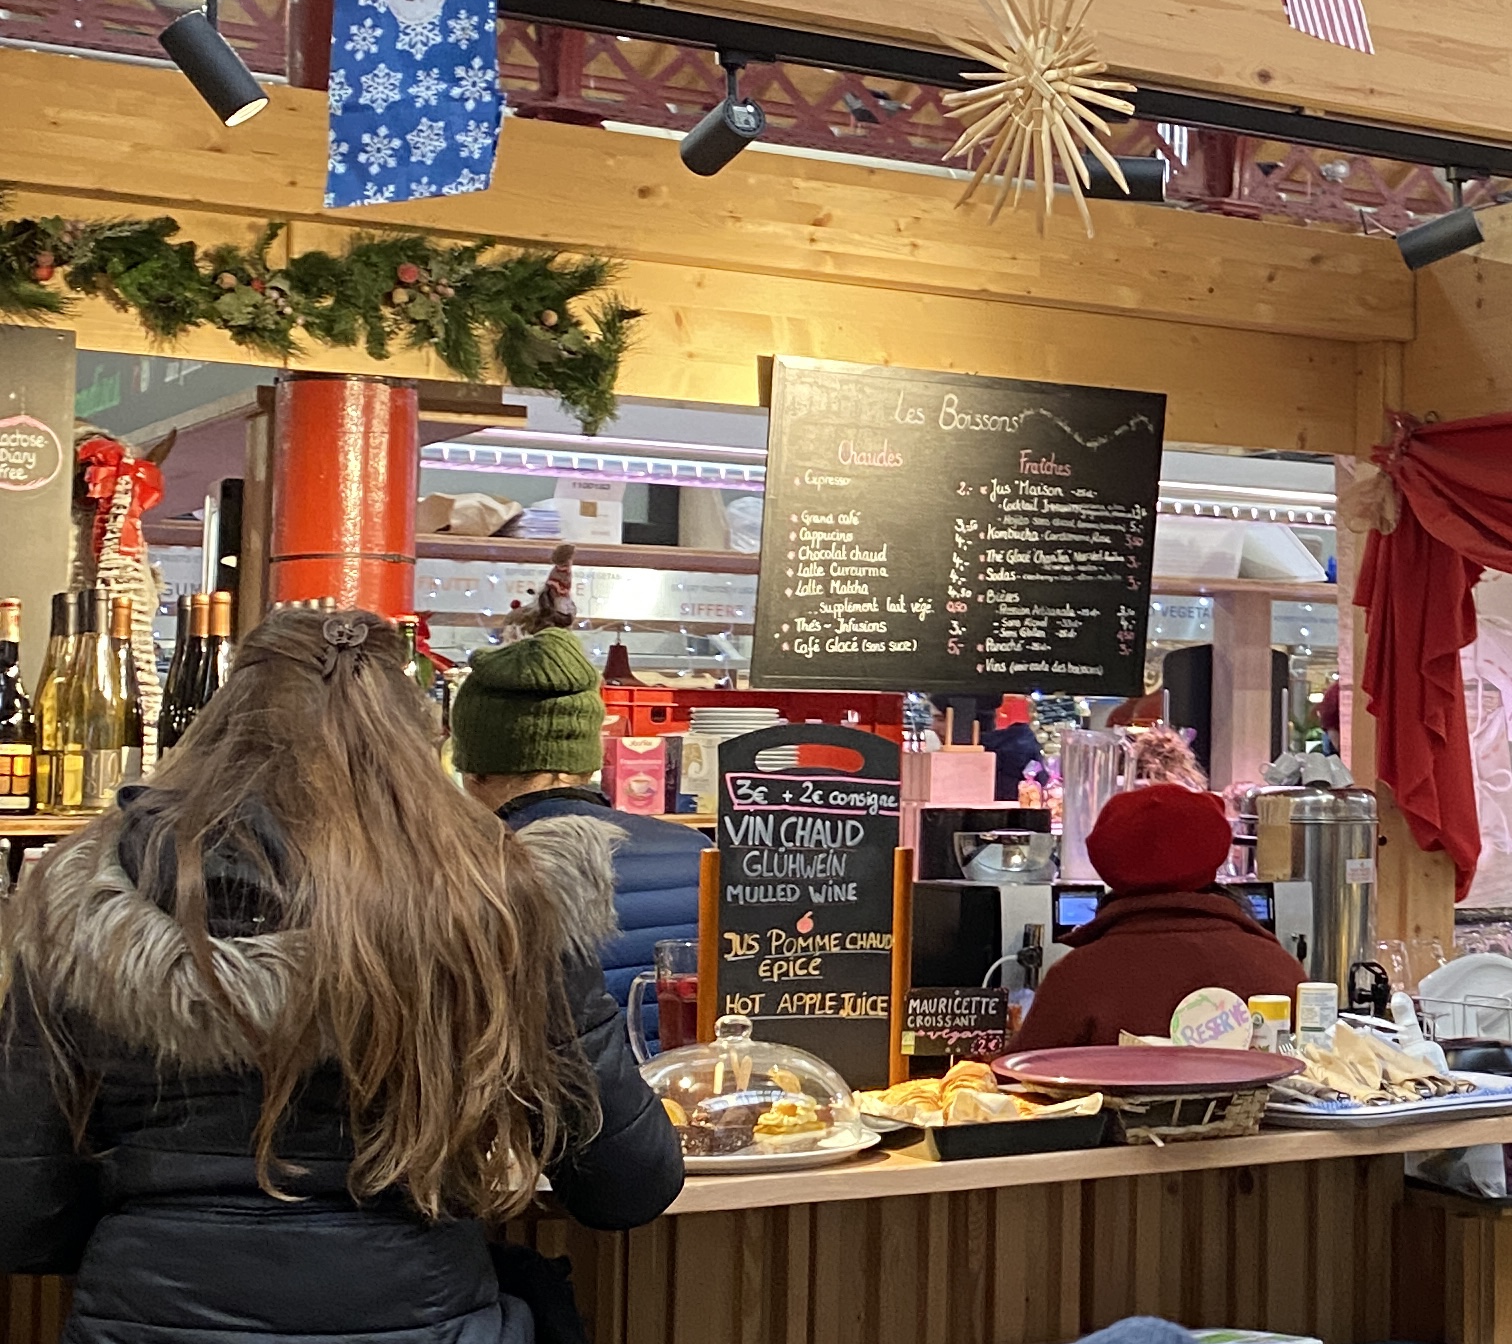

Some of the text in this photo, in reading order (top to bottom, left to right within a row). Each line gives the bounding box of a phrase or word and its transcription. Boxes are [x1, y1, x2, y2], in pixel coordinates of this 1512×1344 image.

[893, 391, 1021, 434] Les Boissons
[837, 438, 904, 468] Chaudes
[1018, 448, 1073, 477] Fraîches
[989, 477, 1013, 504] Jus
[800, 509, 836, 526] Grand
[837, 509, 862, 526] café
[986, 523, 1040, 543] Kombucha
[797, 541, 888, 563] Chocolat chaud
[984, 548, 1005, 564] Thé
[796, 562, 826, 577] Latte
[985, 567, 1016, 582] Sodas
[794, 578, 870, 598] Latte Matcha
[886, 593, 908, 614] lait
[793, 617, 889, 634] Thés Infusions
[793, 635, 822, 657] Café
[825, 636, 860, 654] Glacé
[861, 638, 887, 654] (sans
[985, 657, 1007, 673] Vins
[735, 778, 898, 816] 3€ + 2€ consigne
[723, 813, 865, 849] VIN CHAUD
[725, 878, 858, 905] MULLED WINE
[723, 928, 893, 958] JUS POMME CHAUD
[725, 991, 889, 1018] HOT APPLE JUICE
[907, 996, 1000, 1015] MAURICETTE
[906, 1015, 978, 1028] CROISSANT
[926, 1028, 990, 1045] vegan
